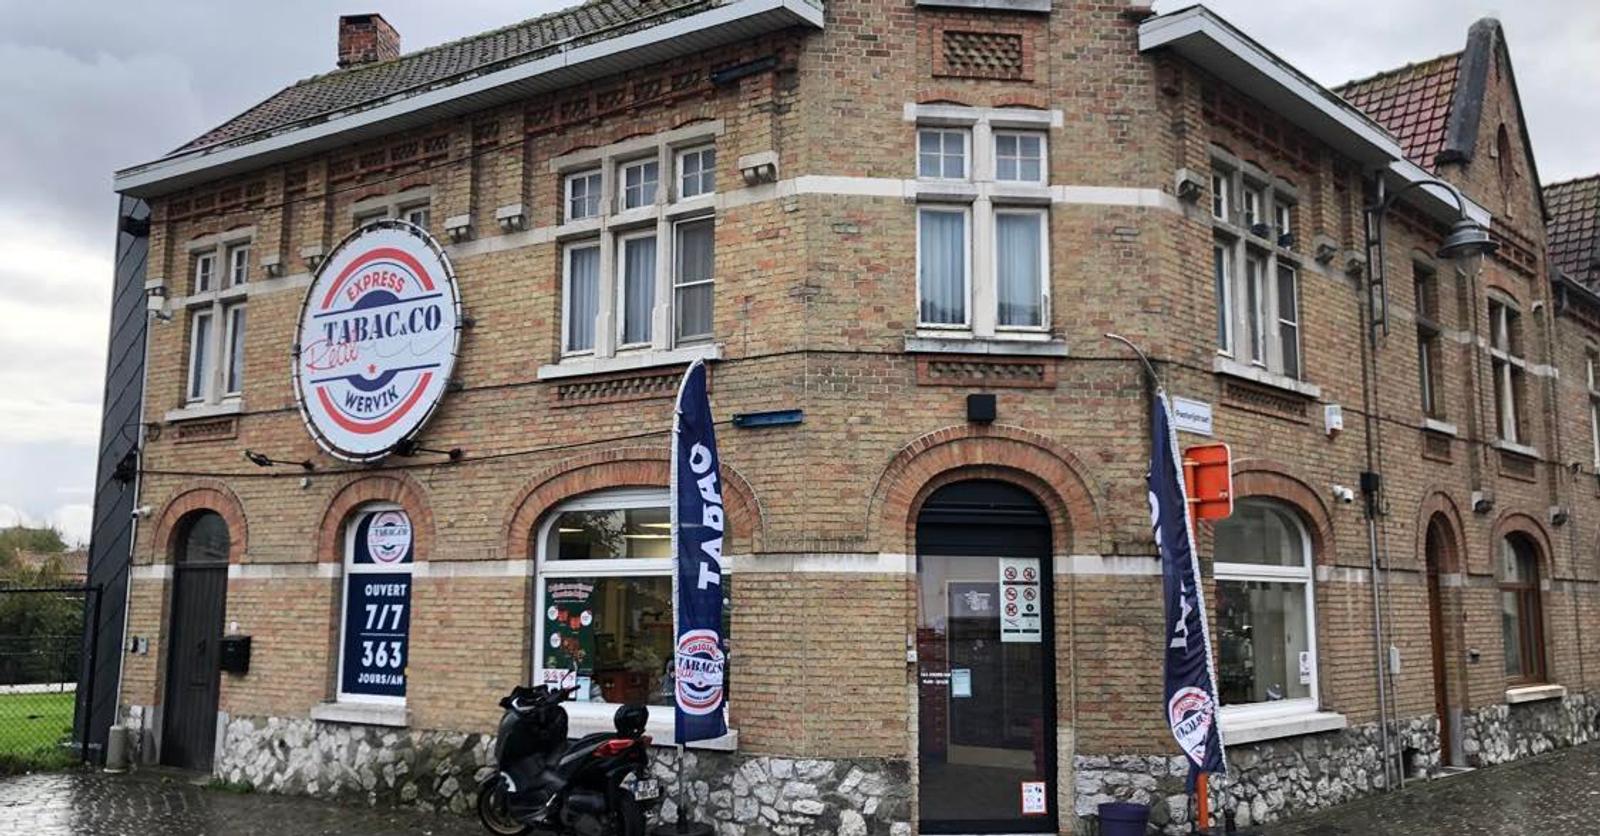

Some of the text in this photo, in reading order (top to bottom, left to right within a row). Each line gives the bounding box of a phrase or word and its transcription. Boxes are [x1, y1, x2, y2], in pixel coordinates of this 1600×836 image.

[346, 271, 405, 301] EXPRESS
[345, 385, 400, 413] WERVIK
[365, 583, 408, 597] OUVERT
[365, 603, 405, 630] 7/7
[361, 641, 403, 668] 363
[358, 673, 404, 686] JOURS/AN
